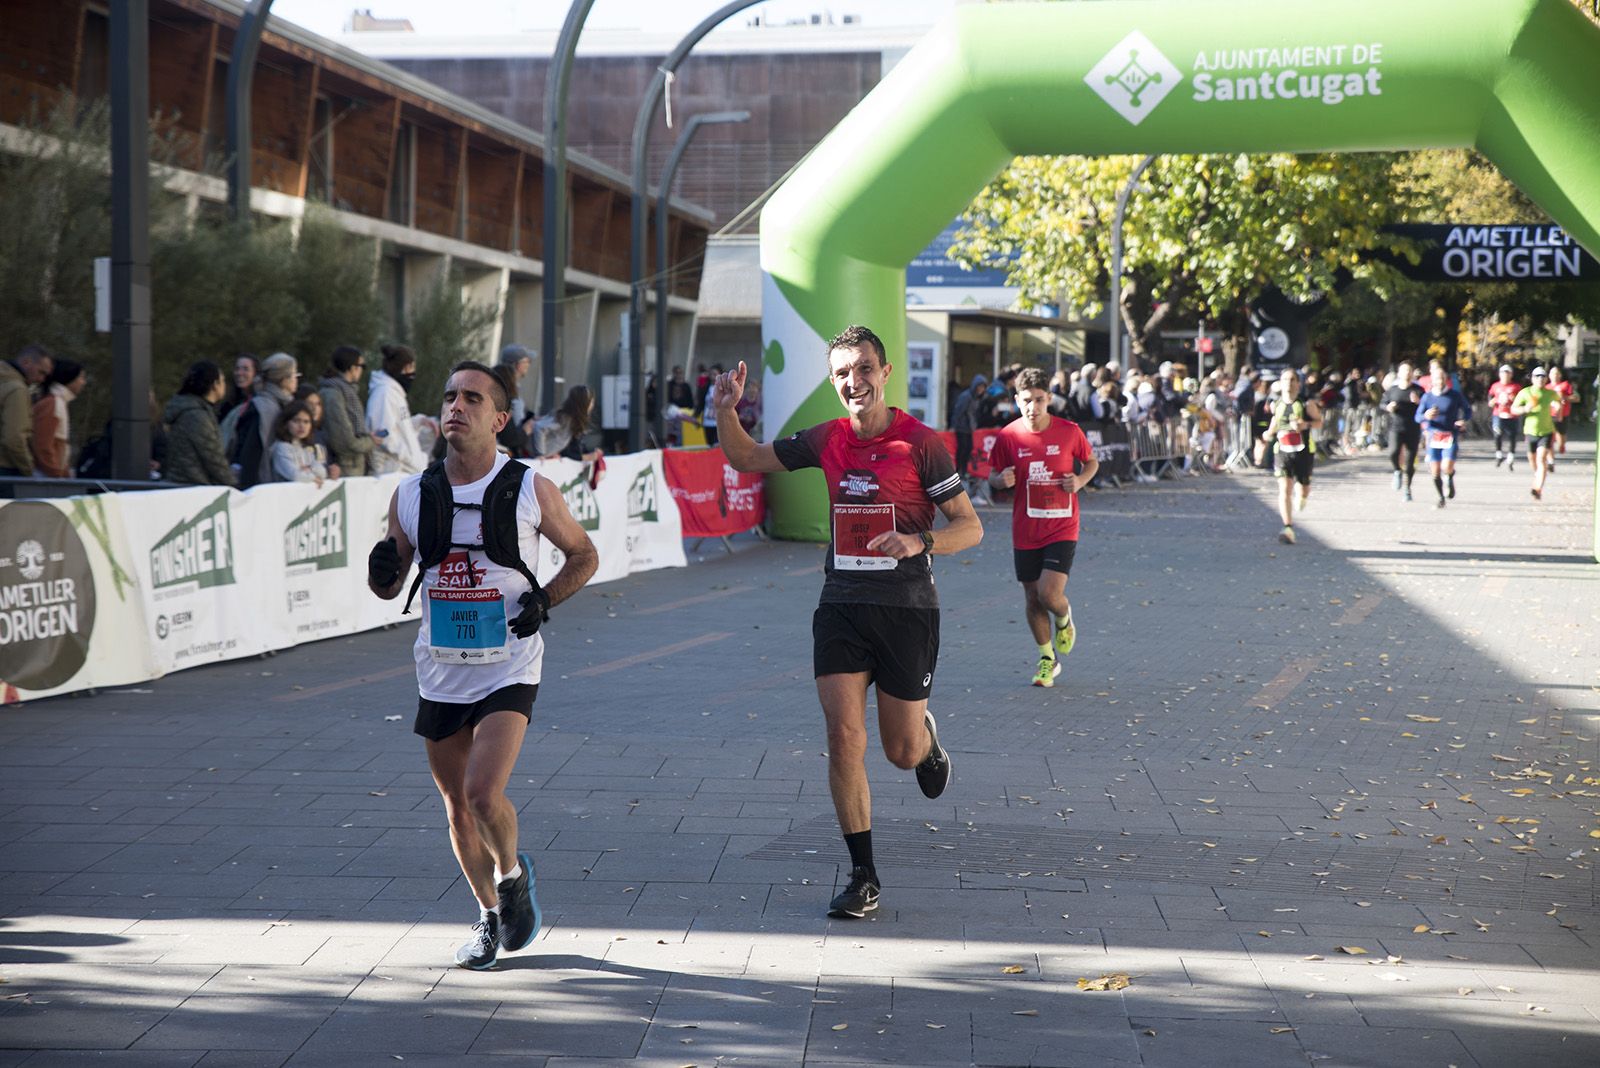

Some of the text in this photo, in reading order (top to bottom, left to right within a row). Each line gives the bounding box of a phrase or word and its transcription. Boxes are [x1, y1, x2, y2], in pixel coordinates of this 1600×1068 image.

[1193, 43, 1383, 70] AJUNTAMENT DE
[1192, 67, 1382, 104] SantCugat
[1443, 247, 1581, 277] ORIGEN
[285, 500, 344, 564] FINISHER
[152, 510, 232, 585] FINISHER
[451, 610, 478, 622] JAVIER
[456, 625, 476, 639] 770
